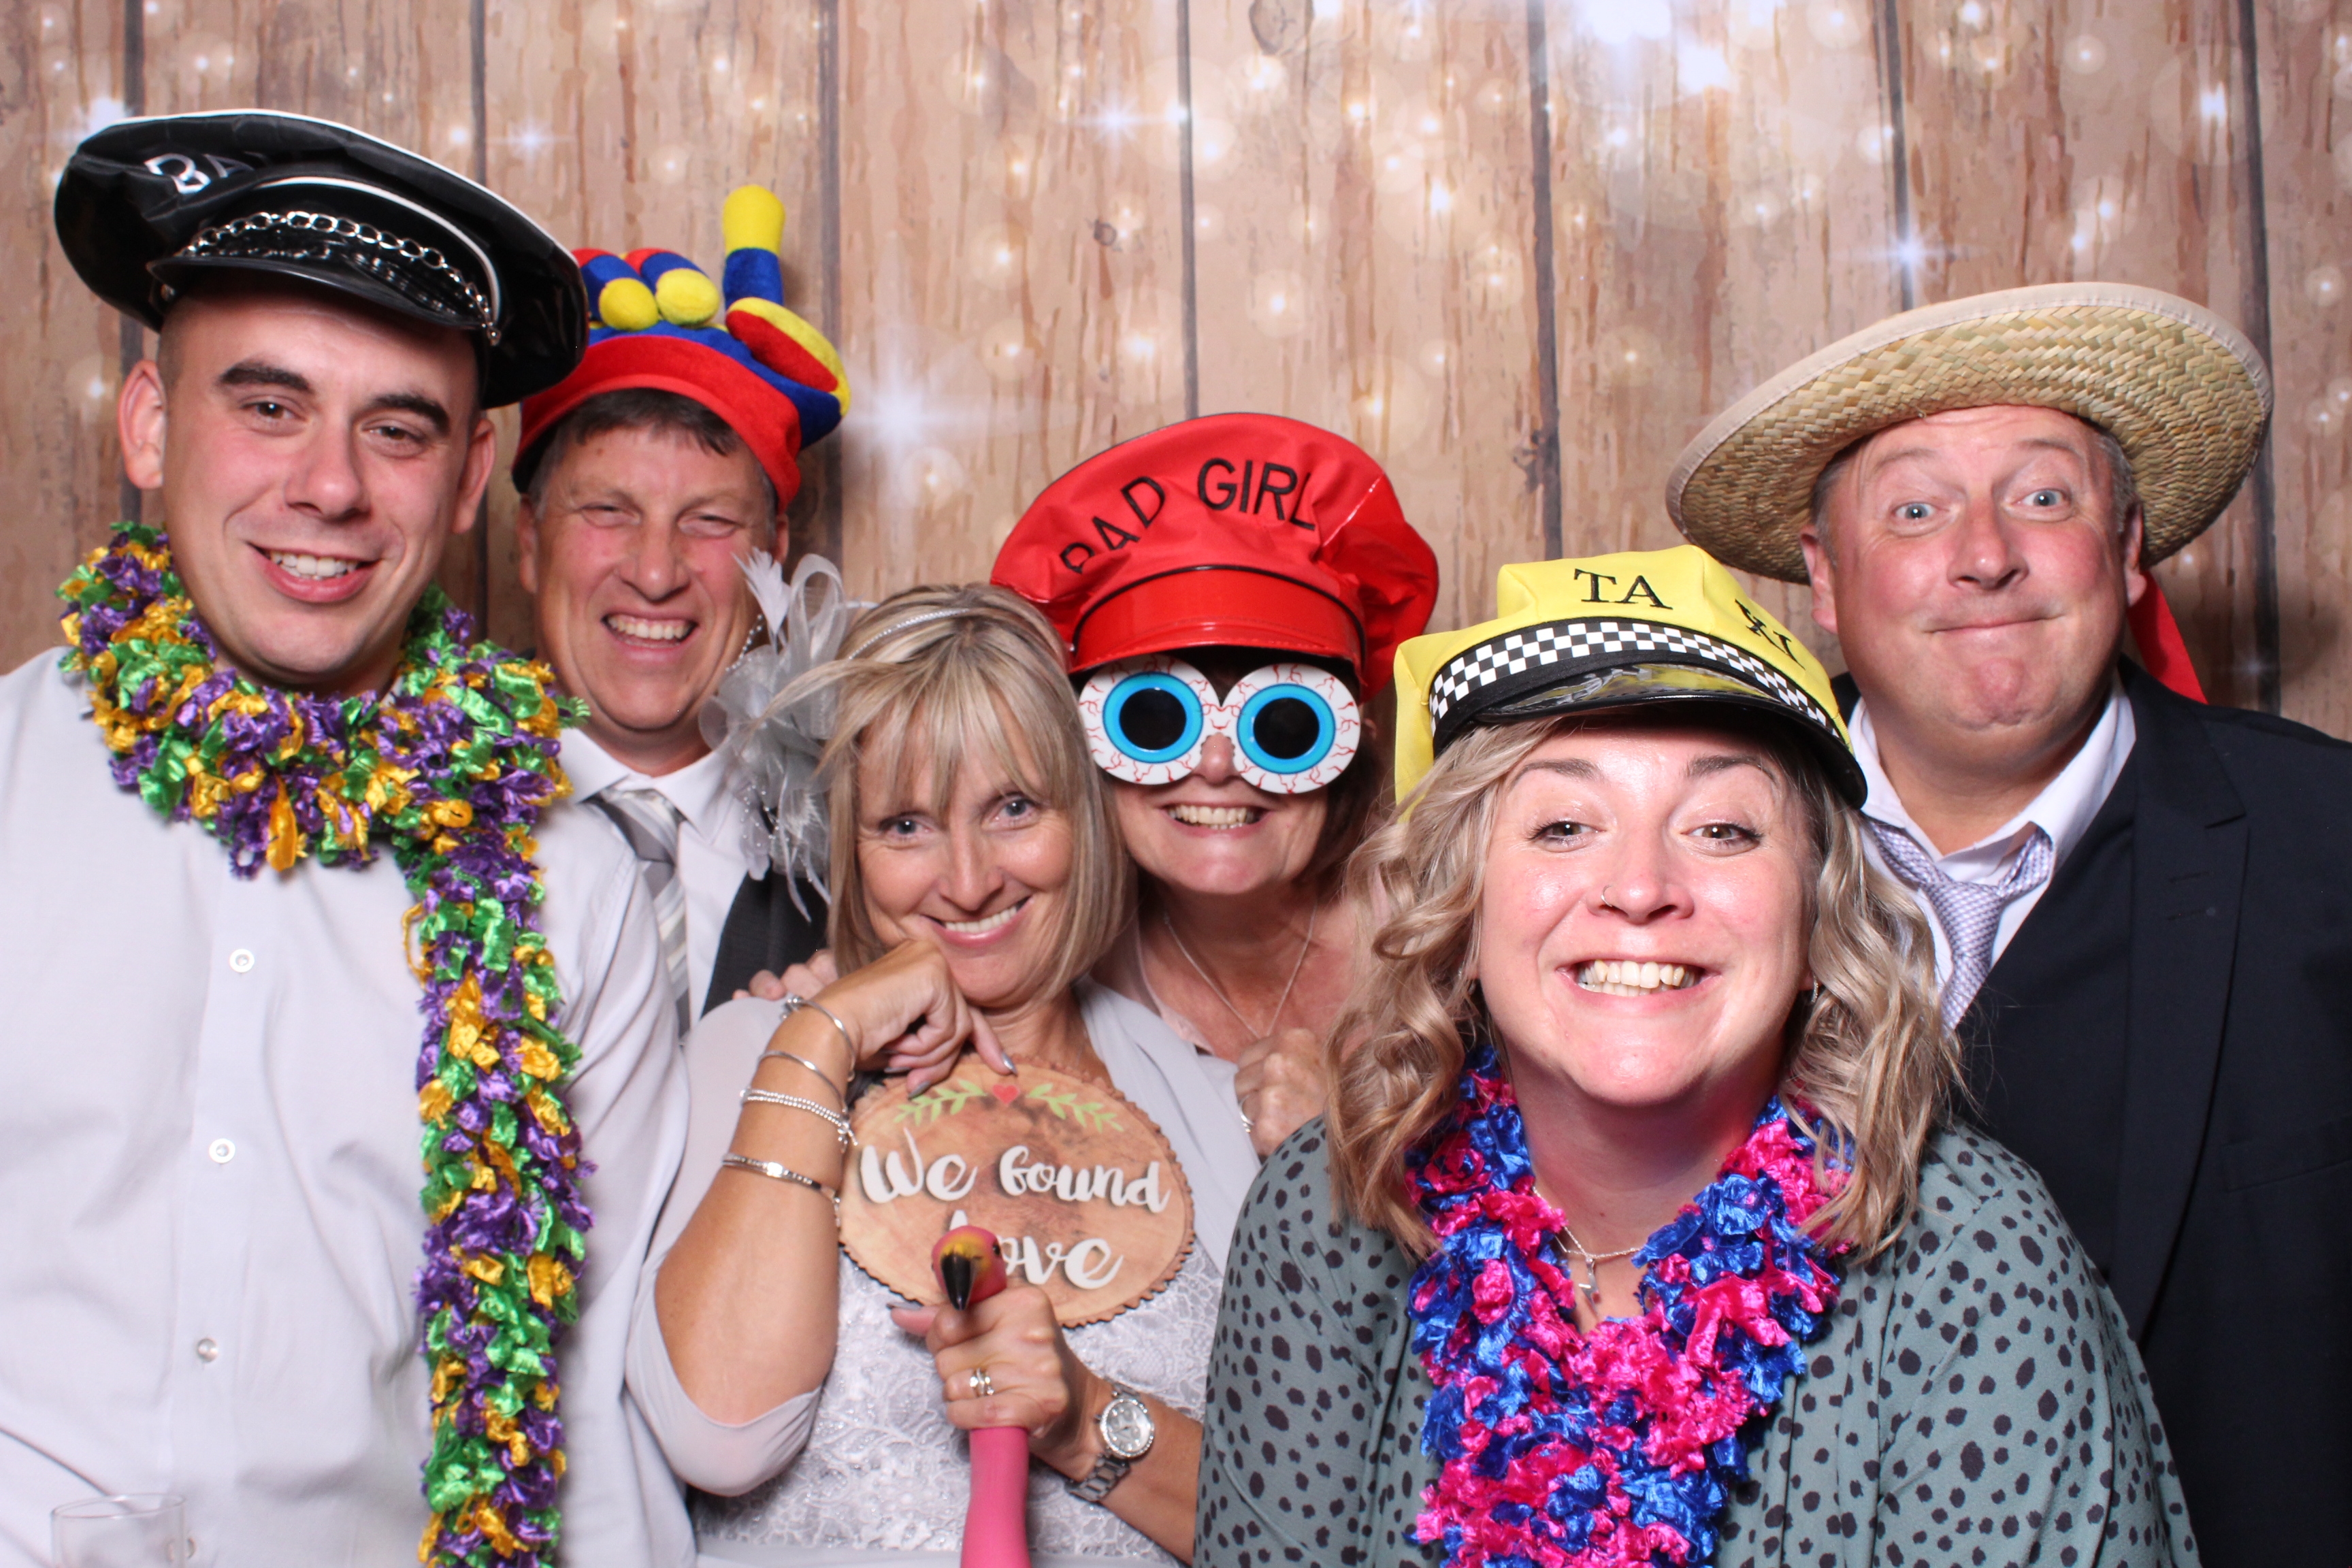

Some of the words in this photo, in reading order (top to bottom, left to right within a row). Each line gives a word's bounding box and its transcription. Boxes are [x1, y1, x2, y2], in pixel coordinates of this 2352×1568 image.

[144, 150, 267, 195] BA
[1198, 458, 1316, 531] GIRL
[860, 1128, 977, 1204] We
[999, 1145, 1171, 1213] found
[949, 1209, 1124, 1289] ove
